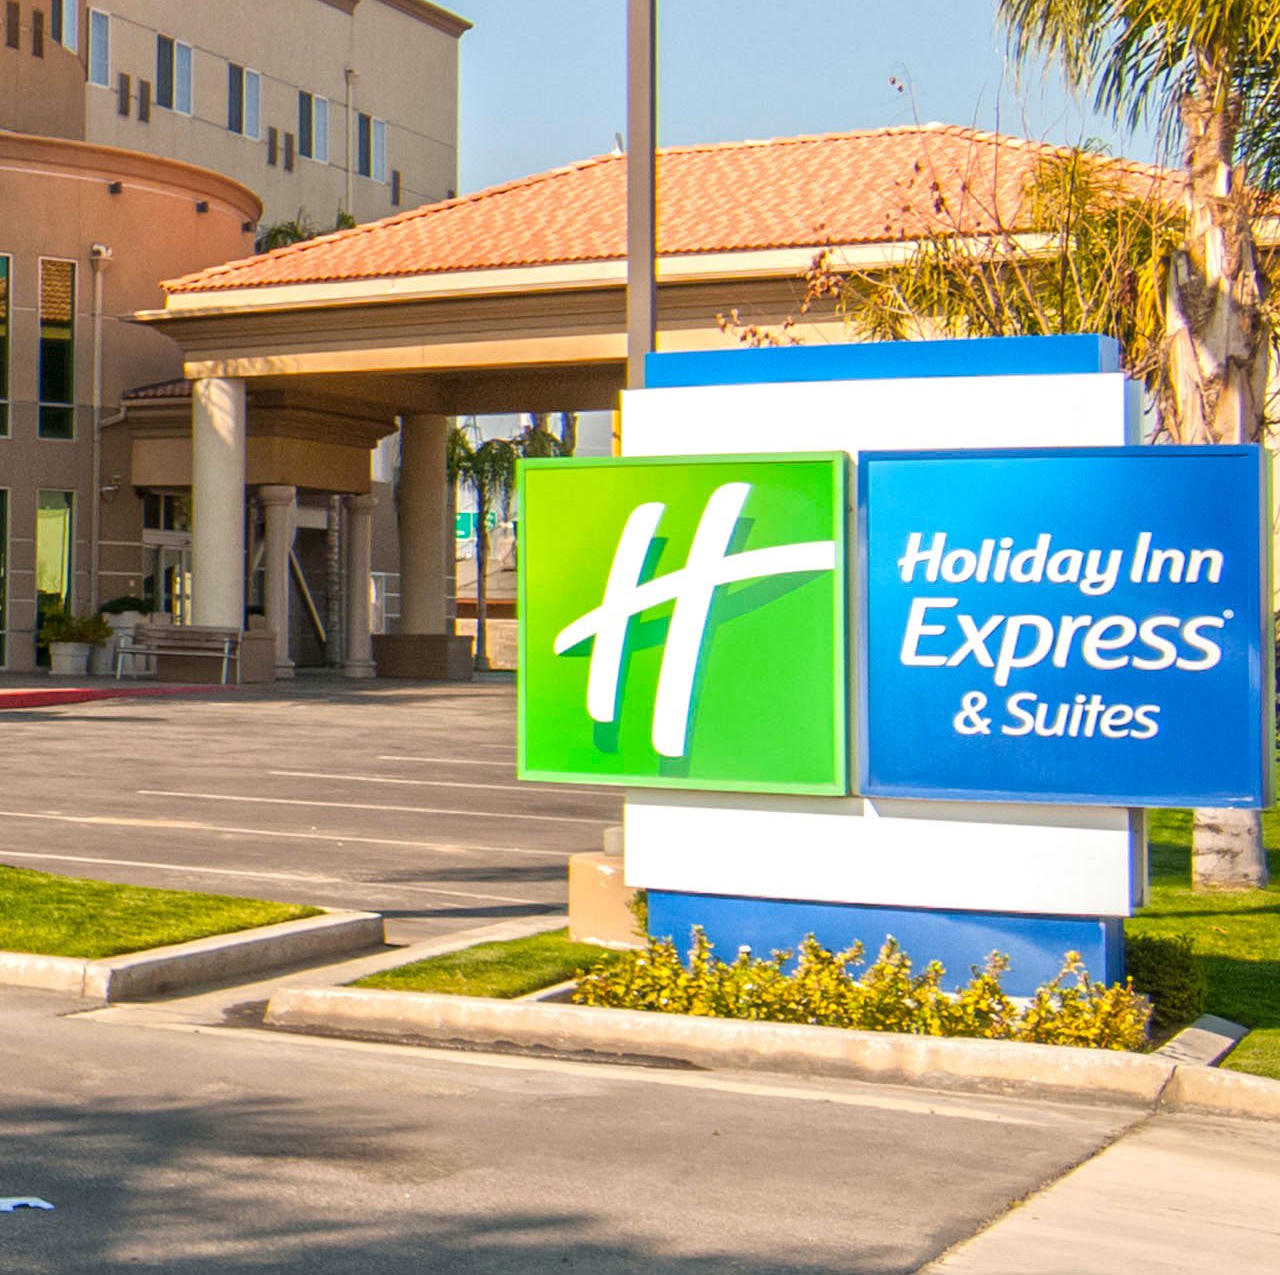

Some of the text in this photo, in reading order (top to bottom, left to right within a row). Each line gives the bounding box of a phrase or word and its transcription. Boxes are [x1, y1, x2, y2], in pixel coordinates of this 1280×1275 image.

[897, 531, 1225, 596] Holiday Inn
[953, 690, 1161, 740] & Suites
